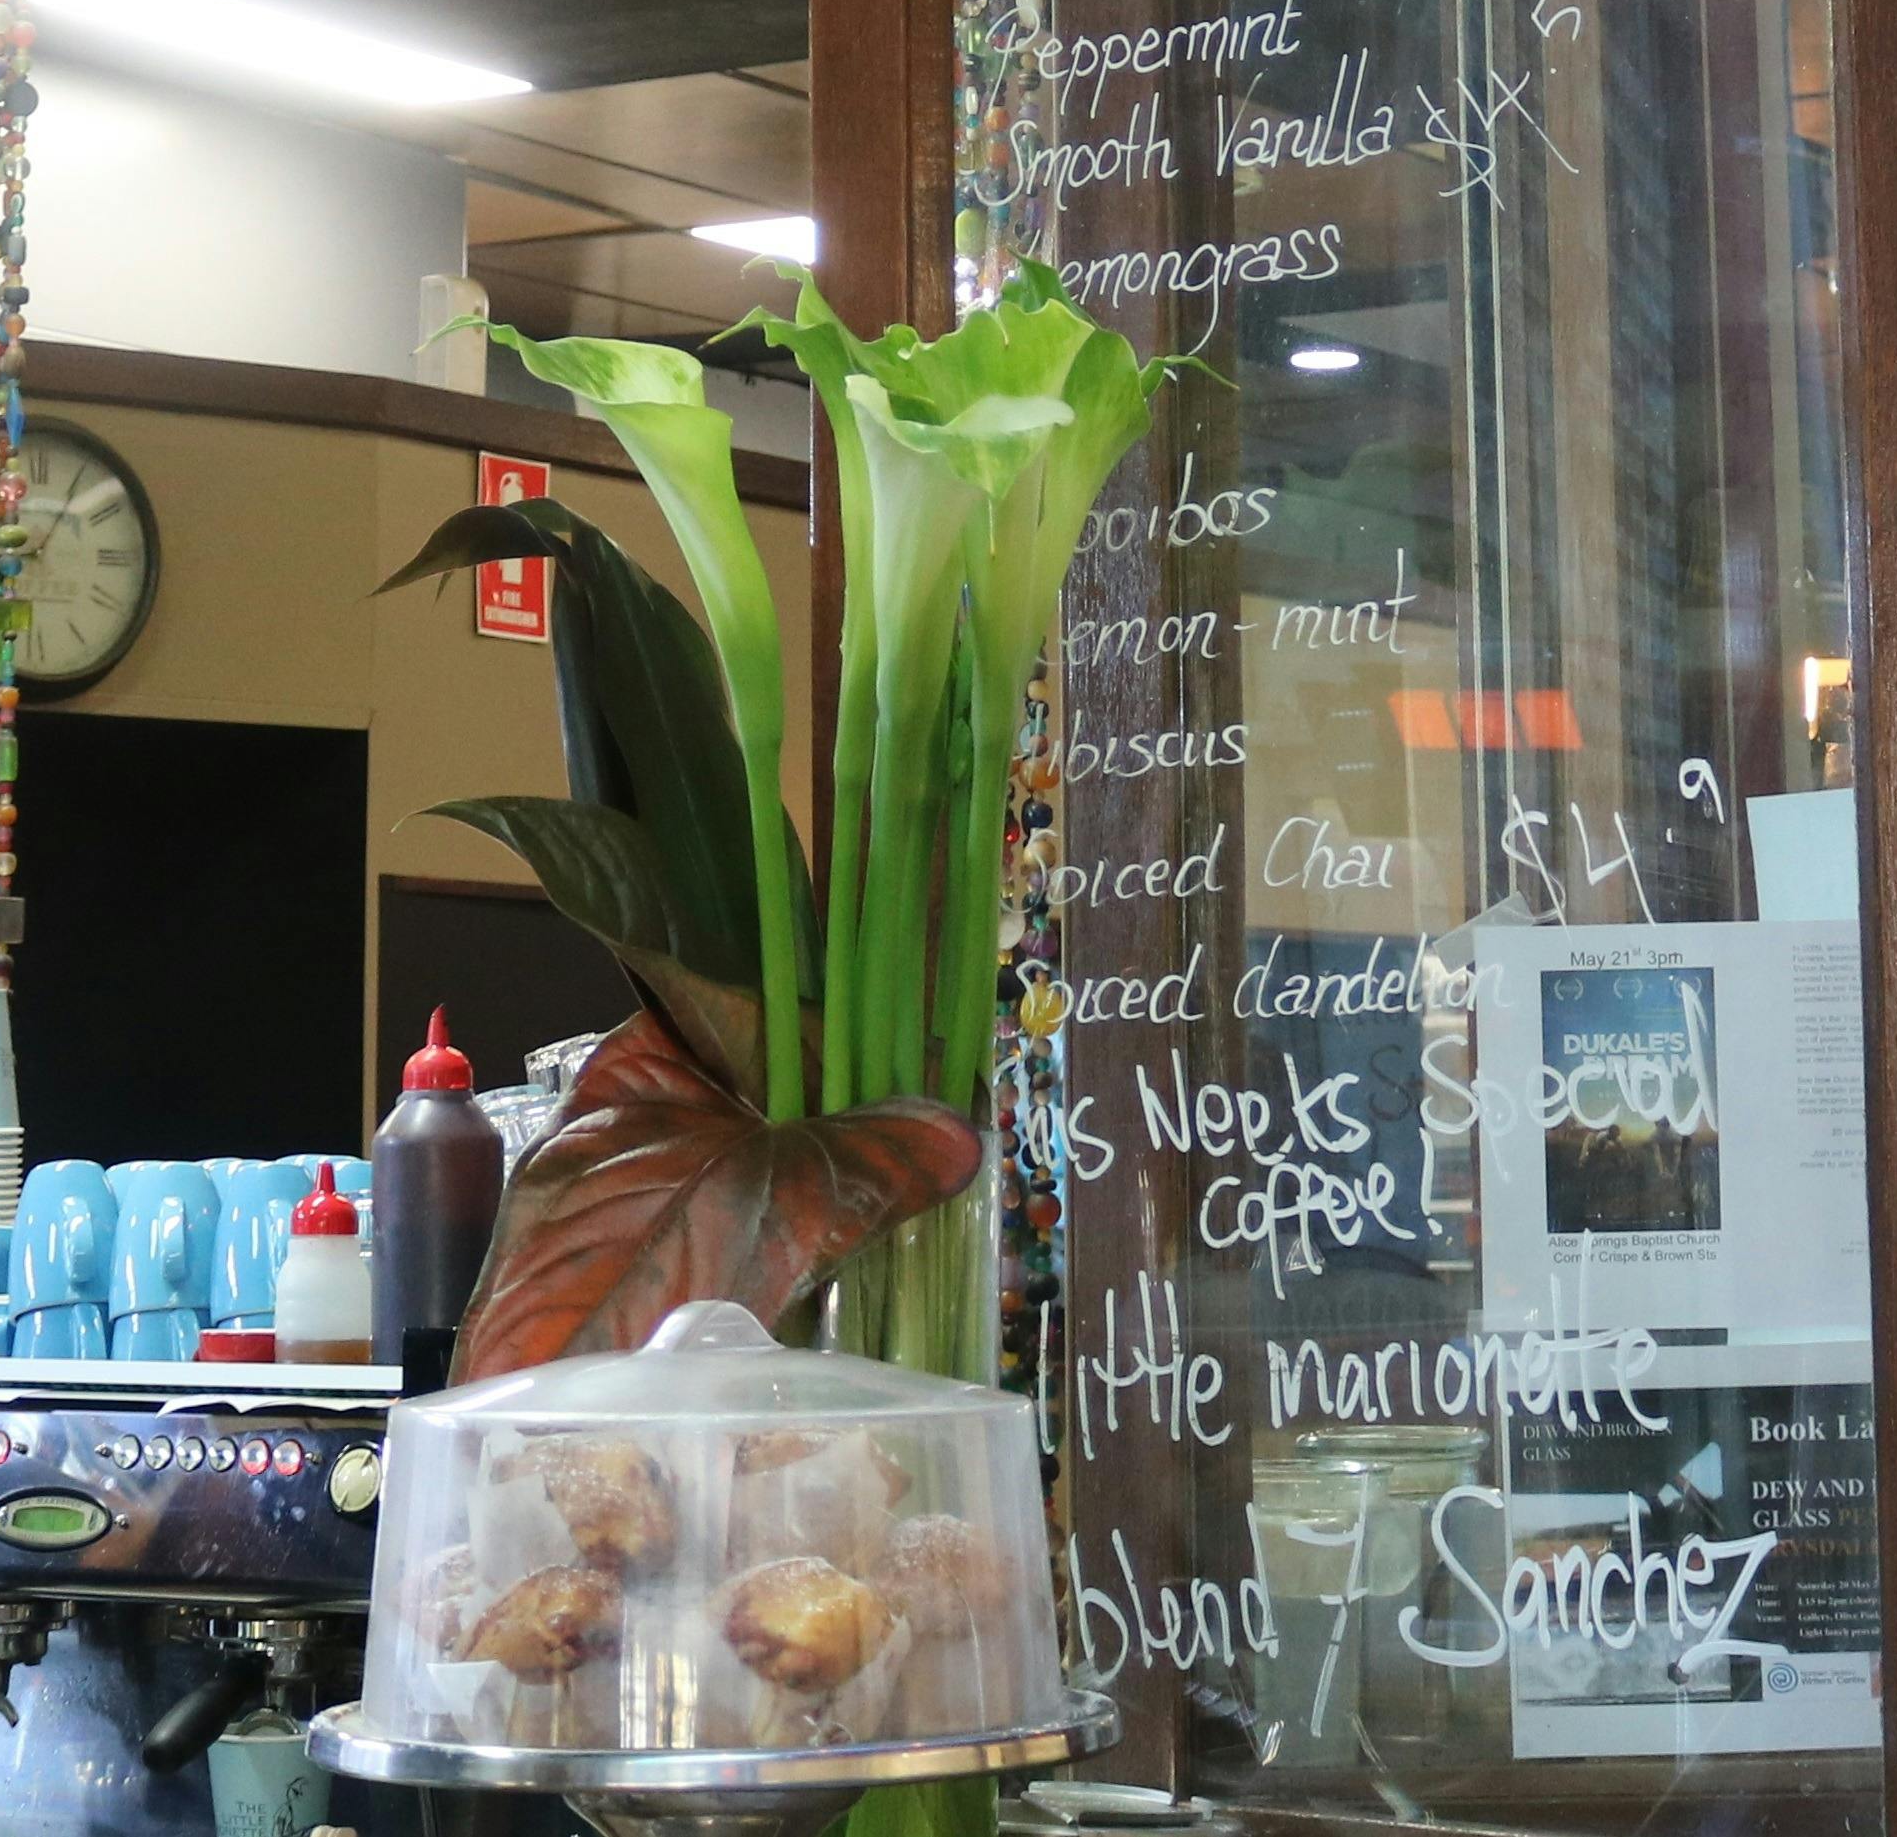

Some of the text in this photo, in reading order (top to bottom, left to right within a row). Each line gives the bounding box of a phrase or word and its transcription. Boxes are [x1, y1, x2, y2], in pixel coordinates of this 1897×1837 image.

[974, 48, 1395, 211] Smooth Vanilla
[1025, 222, 1341, 355] emongrass
[1264, 817, 1394, 889] Chai
[1569, 951, 1606, 968] May
[1647, 949, 1685, 969] 3pm
[1563, 1031, 1687, 1056] DUKALE'S
[1548, 1232, 1721, 1251] Alice prings Baptist Church
[1654, 1249, 1694, 1262] Brown
[1750, 1415, 1826, 1444] Book
[1752, 1479, 1865, 1501] DEW AND
[1752, 1508, 1832, 1531] GLASS
[1068, 1504, 1280, 1684] blend
